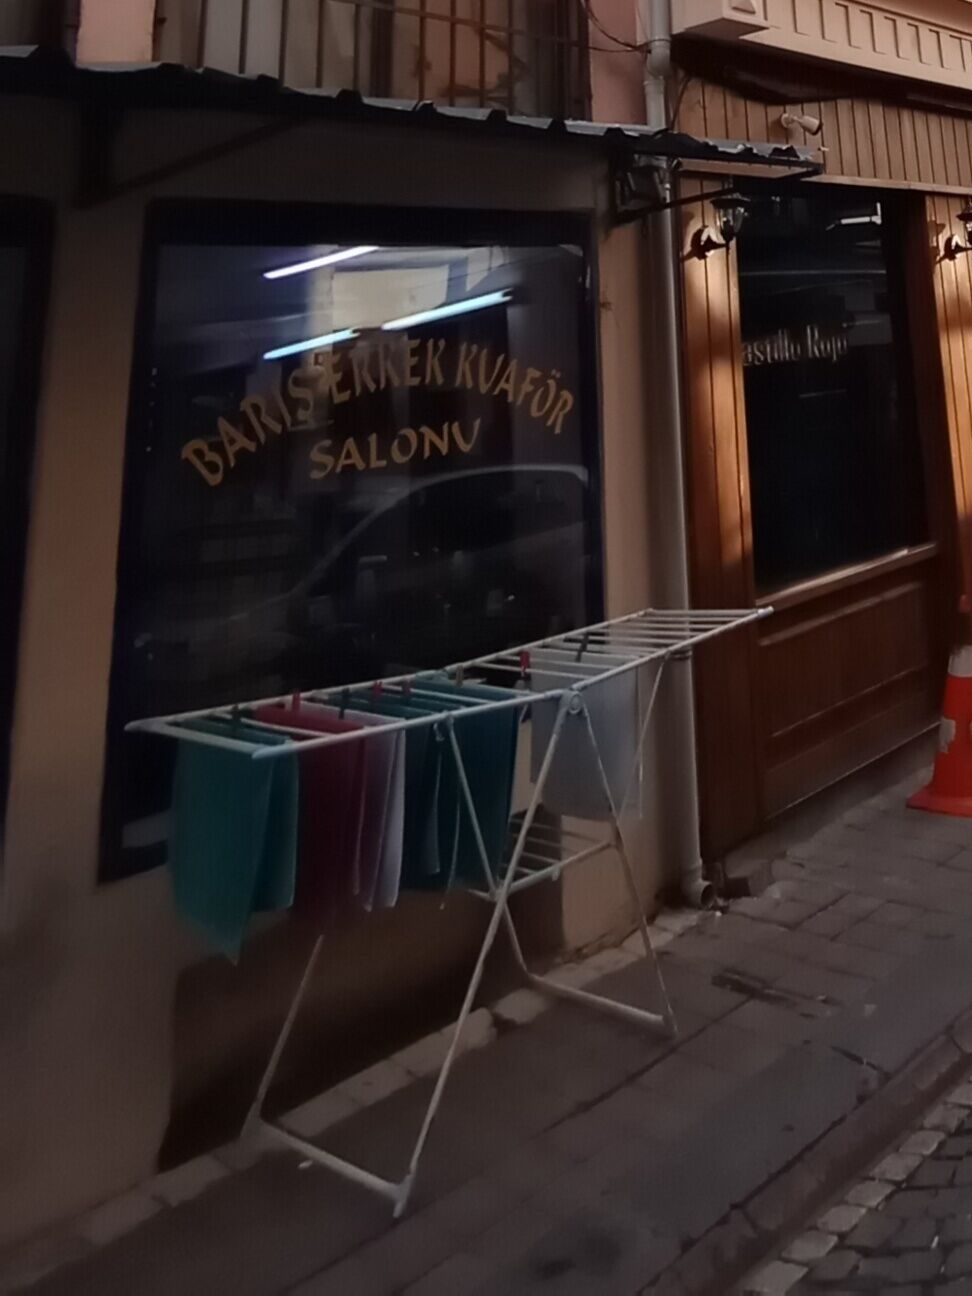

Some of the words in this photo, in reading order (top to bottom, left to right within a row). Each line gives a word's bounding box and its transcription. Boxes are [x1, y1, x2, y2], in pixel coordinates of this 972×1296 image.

[742, 328, 801, 366] astillo
[806, 324, 848, 363] Rojo
[318, 338, 446, 405] ERKEK
[455, 341, 575, 435] KUAFÖR
[309, 417, 482, 480] SALONU
